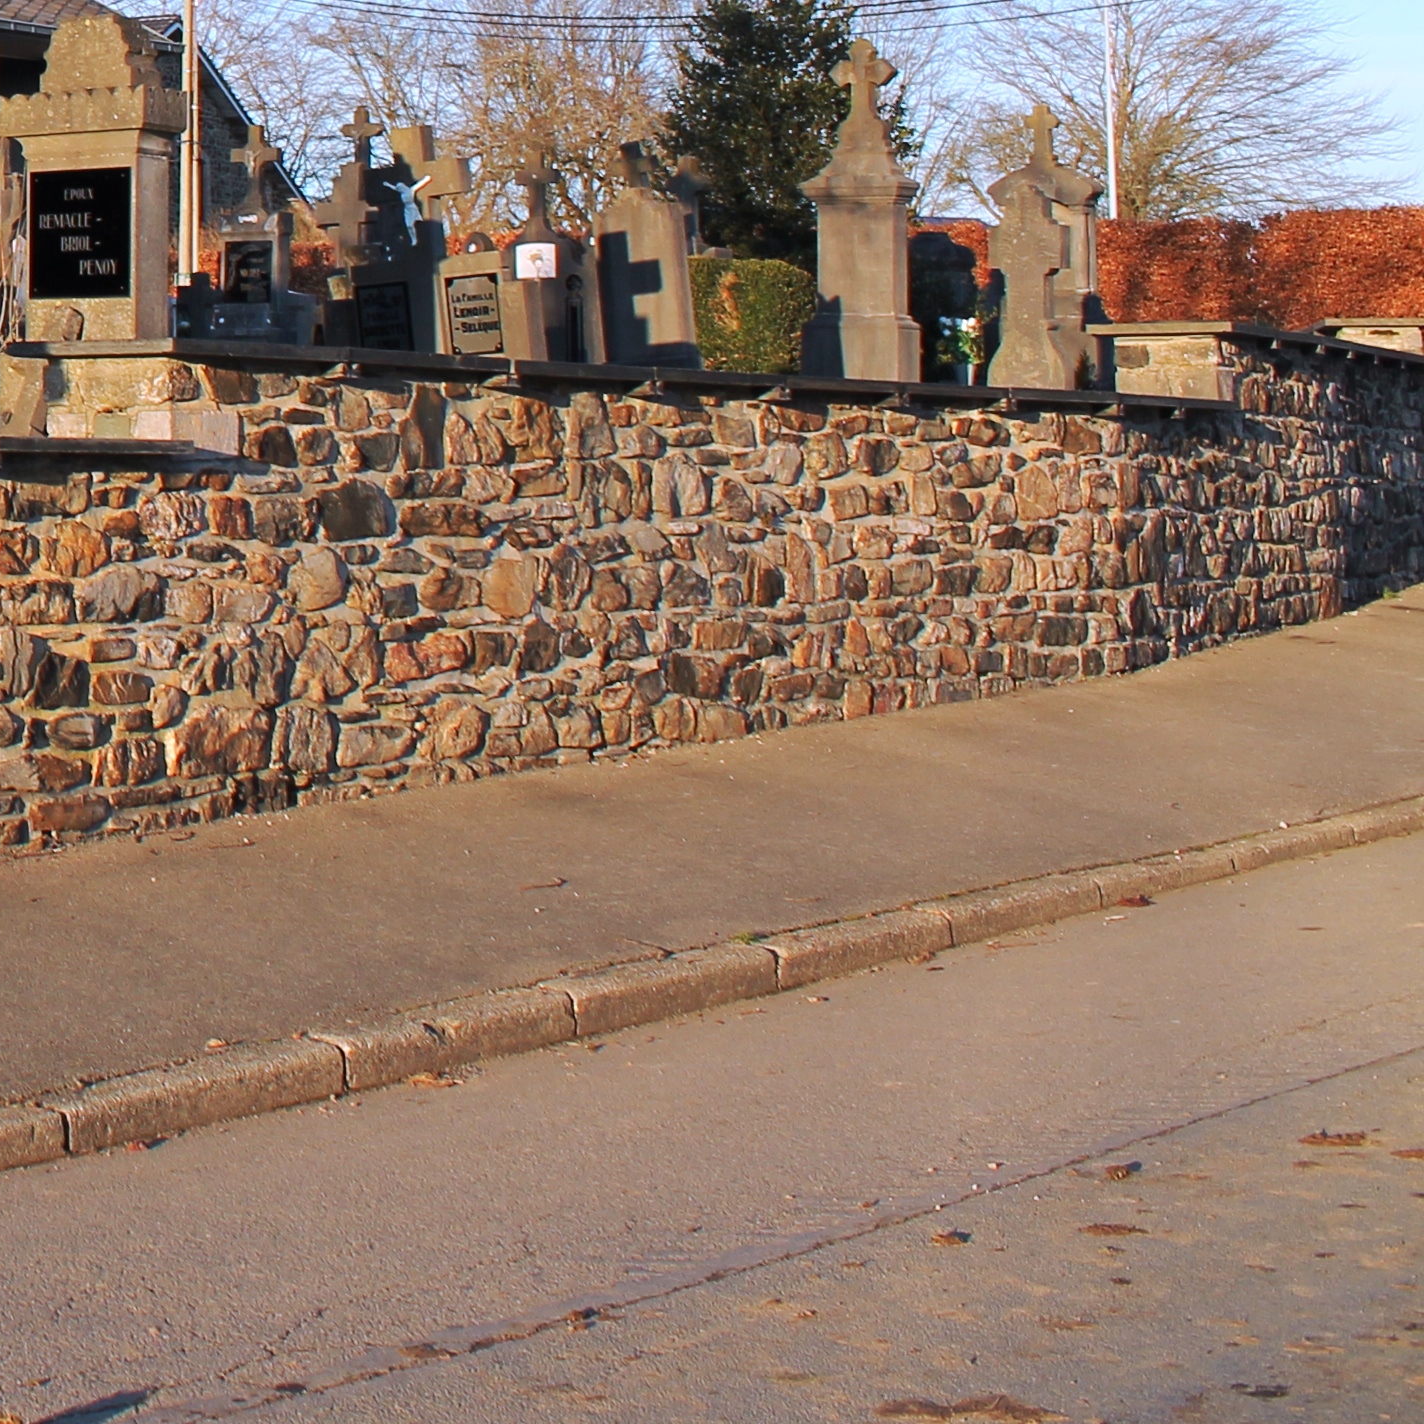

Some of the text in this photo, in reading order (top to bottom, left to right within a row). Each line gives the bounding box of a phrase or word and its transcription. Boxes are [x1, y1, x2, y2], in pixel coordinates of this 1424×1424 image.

[64, 187, 95, 201] EPOUX
[38, 212, 92, 229] REMACLE
[60, 235, 93, 252] BRIOL
[79, 258, 118, 276] PENOY
